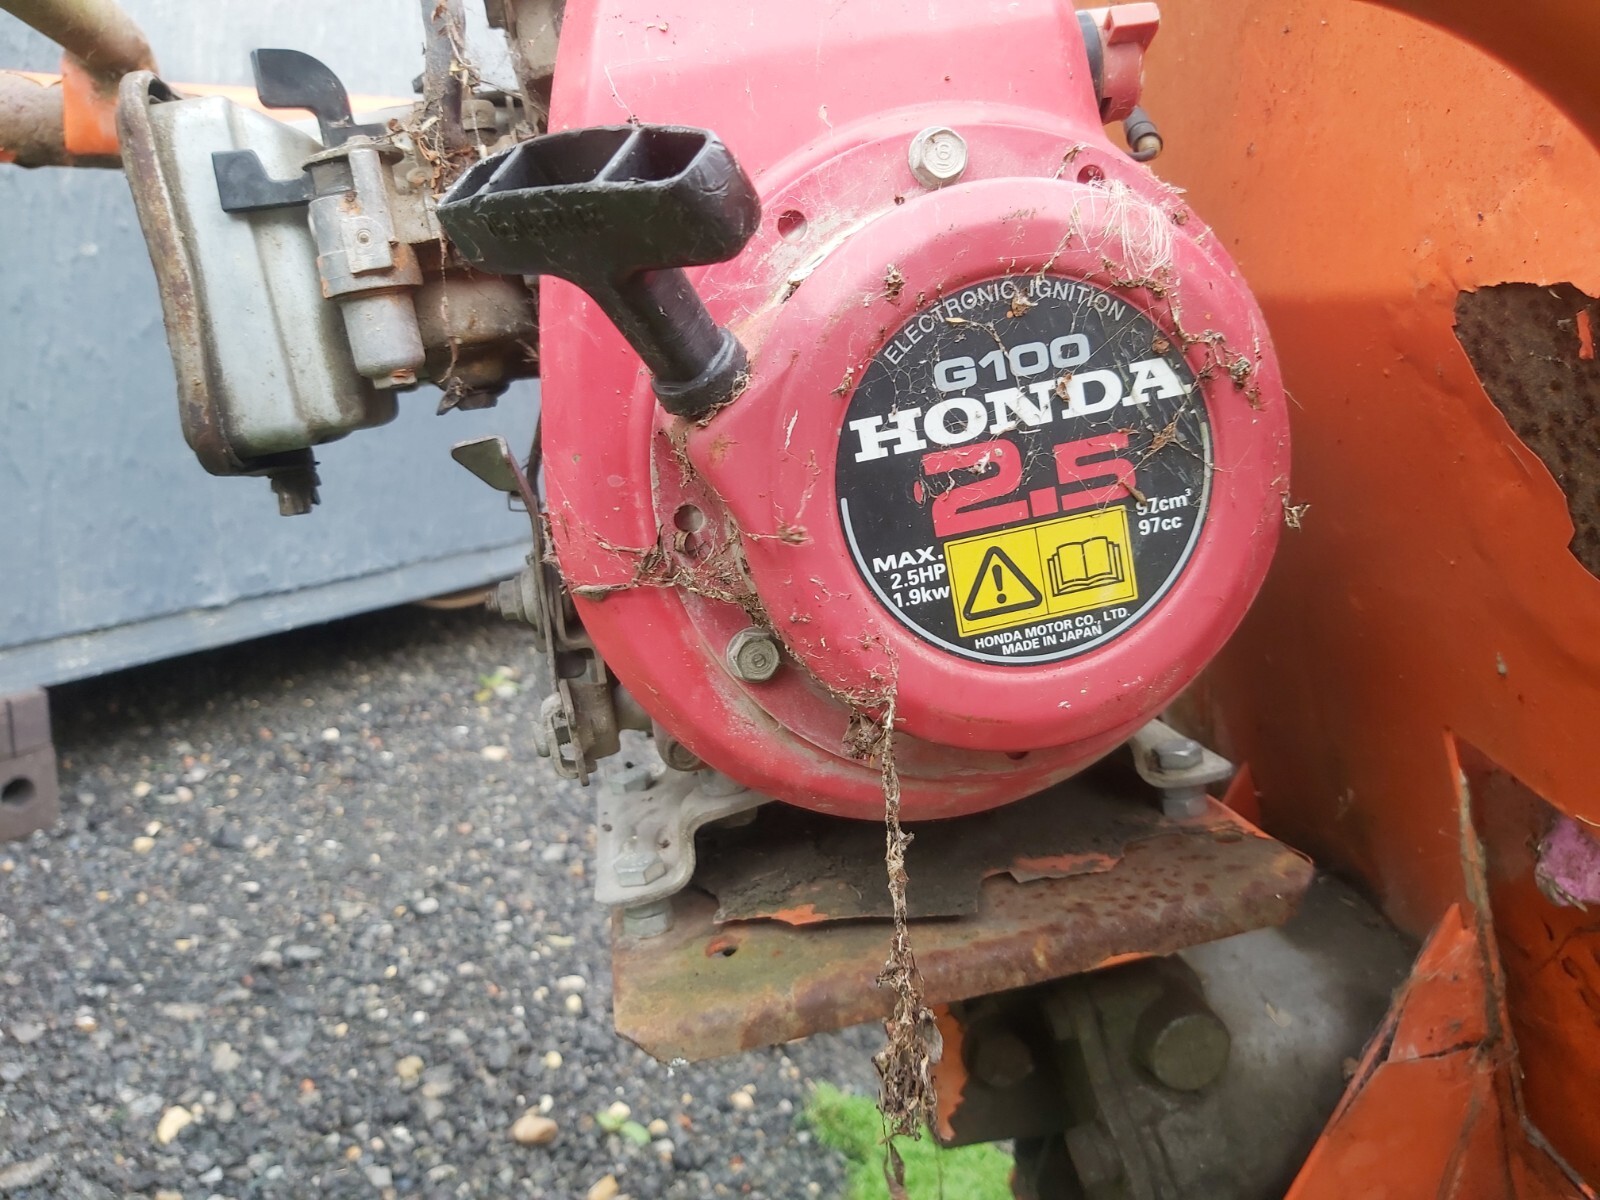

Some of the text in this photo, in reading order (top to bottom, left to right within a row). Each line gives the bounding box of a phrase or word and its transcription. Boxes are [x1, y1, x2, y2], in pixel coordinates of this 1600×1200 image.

[884, 279, 1126, 364] ELECTRONIC IGNITION
[933, 333, 1090, 392] G100
[849, 357, 1192, 462] HONDA
[920, 432, 1137, 538] 2.5
[1138, 516, 1182, 536] 97cc
[872, 546, 944, 573] MAX.
[890, 563, 946, 590] 2.5HP
[975, 630, 1022, 649] HONDA
[1024, 619, 1073, 638] MOTOR
[1103, 607, 1131, 622] LTD.
[1002, 624, 1102, 655] MADE IN JAPAN
